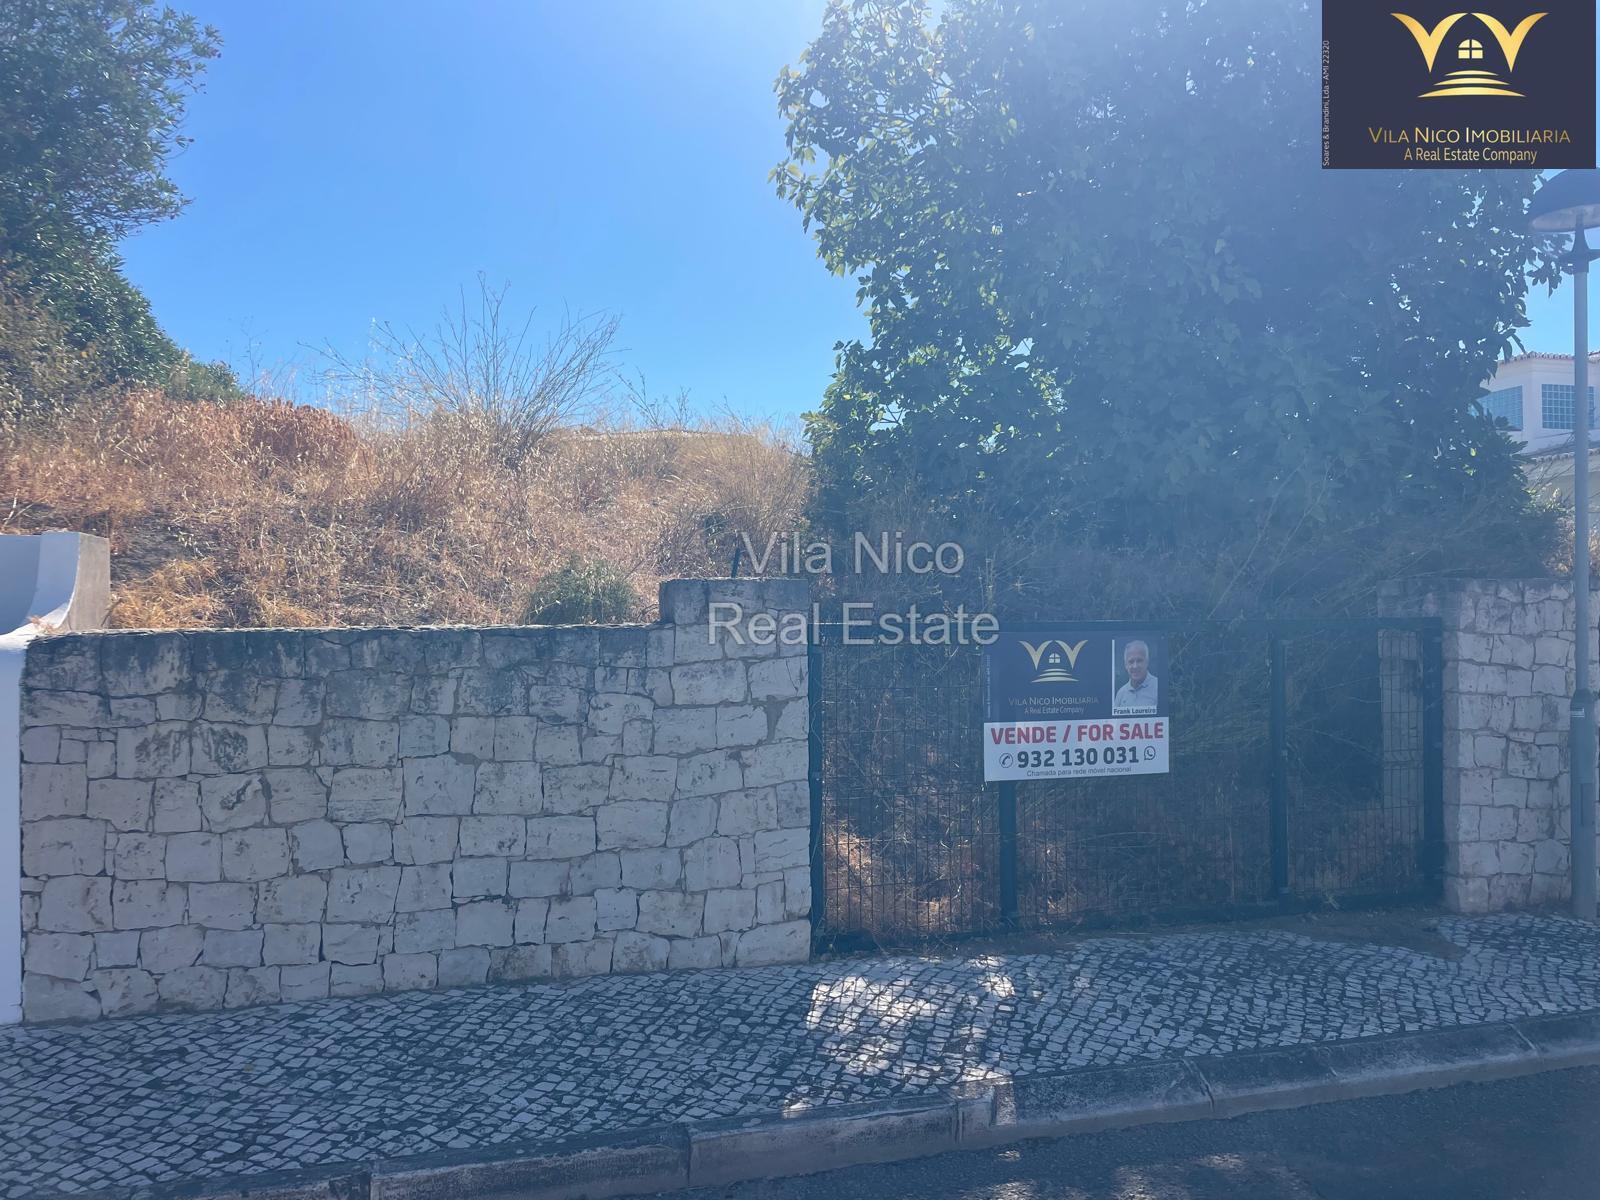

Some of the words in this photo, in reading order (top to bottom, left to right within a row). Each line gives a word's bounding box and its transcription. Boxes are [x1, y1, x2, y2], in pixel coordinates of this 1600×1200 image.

[1009, 697, 1027, 706] VILA
[1029, 696, 1050, 706] NICO
[1052, 696, 1099, 705] IMOBILIARIA
[1042, 706, 1059, 714] Estate
[1060, 706, 1084, 715] Company
[991, 725, 1057, 745] VENDE
[1062, 724, 1072, 743] /
[1077, 723, 1114, 742] FOR
[1119, 722, 1164, 740] SALE
[1017, 750, 1055, 768] 932
[1061, 748, 1098, 766] 130
[1103, 746, 1140, 765] 031
[1026, 769, 1056, 777] Chamada
[1057, 769, 1072, 777] para
[1087, 767, 1106, 775] móvel
[1106, 766, 1132, 774] nacional
